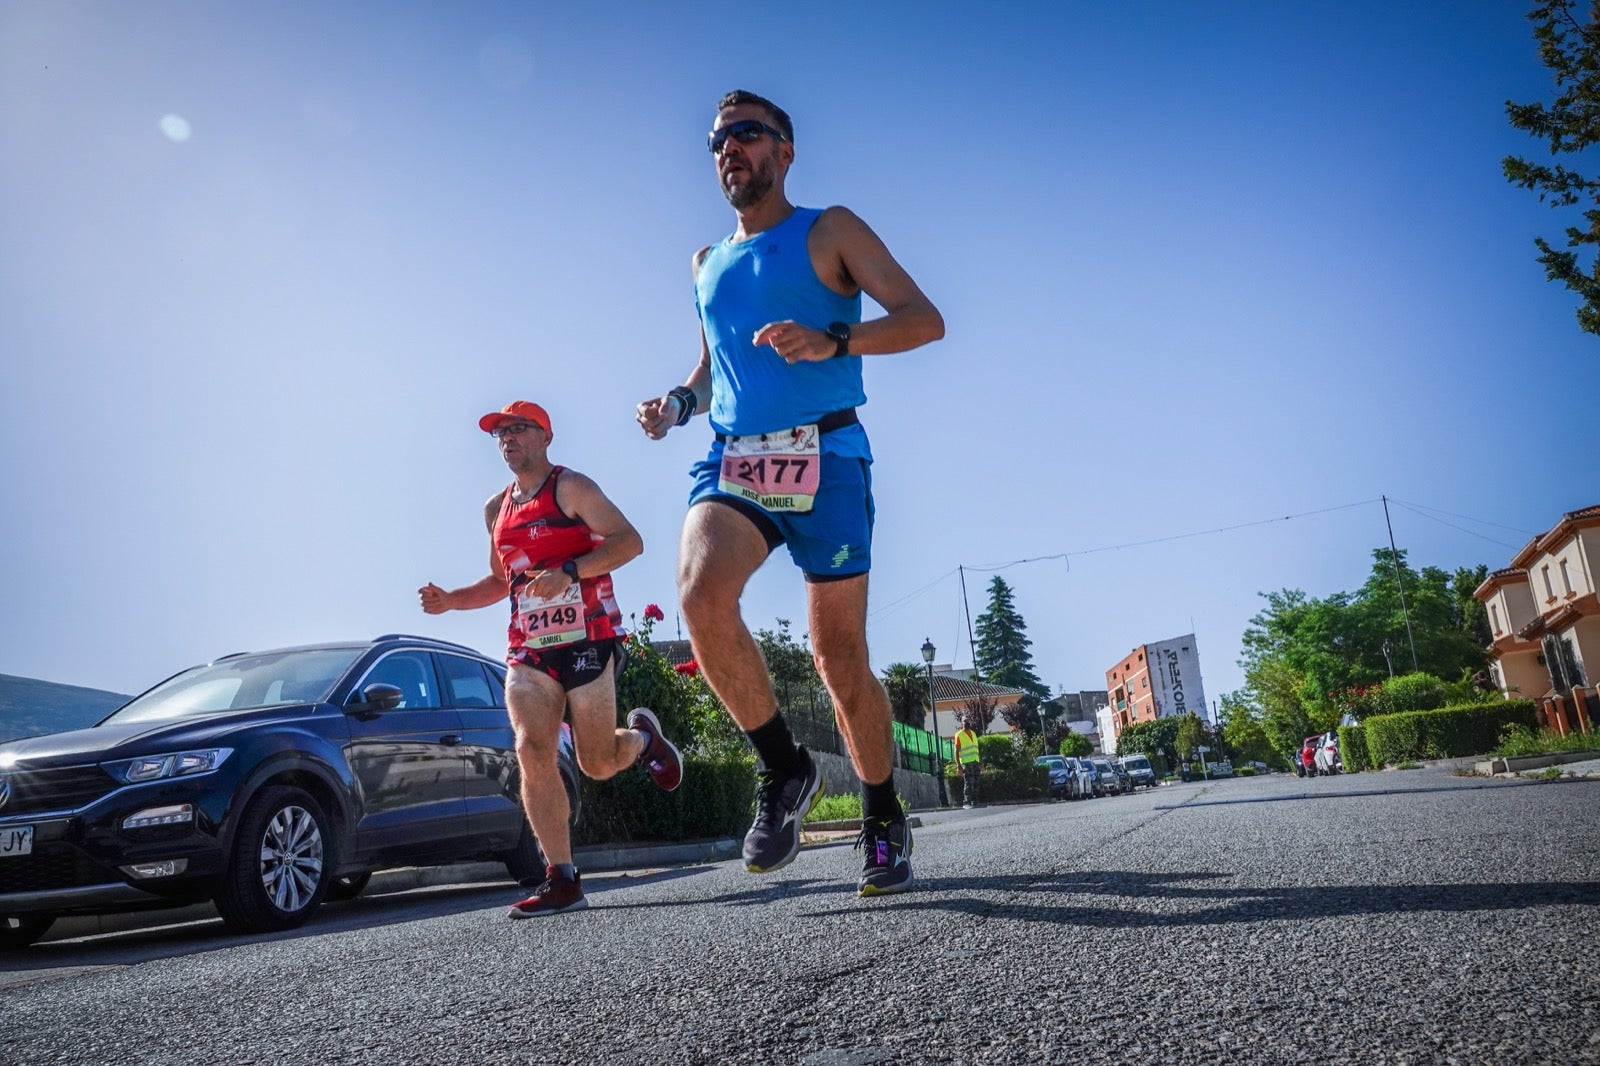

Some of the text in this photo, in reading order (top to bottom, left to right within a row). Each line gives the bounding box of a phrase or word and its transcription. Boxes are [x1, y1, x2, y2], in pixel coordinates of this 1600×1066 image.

[737, 458, 809, 484] 2177
[741, 488, 796, 508] JOSE MANUEL
[528, 607, 577, 632] 2149
[539, 634, 563, 646] SAMUEL
[1167, 650, 1187, 715] BIOSFERA
[0, 831, 26, 852] JY
